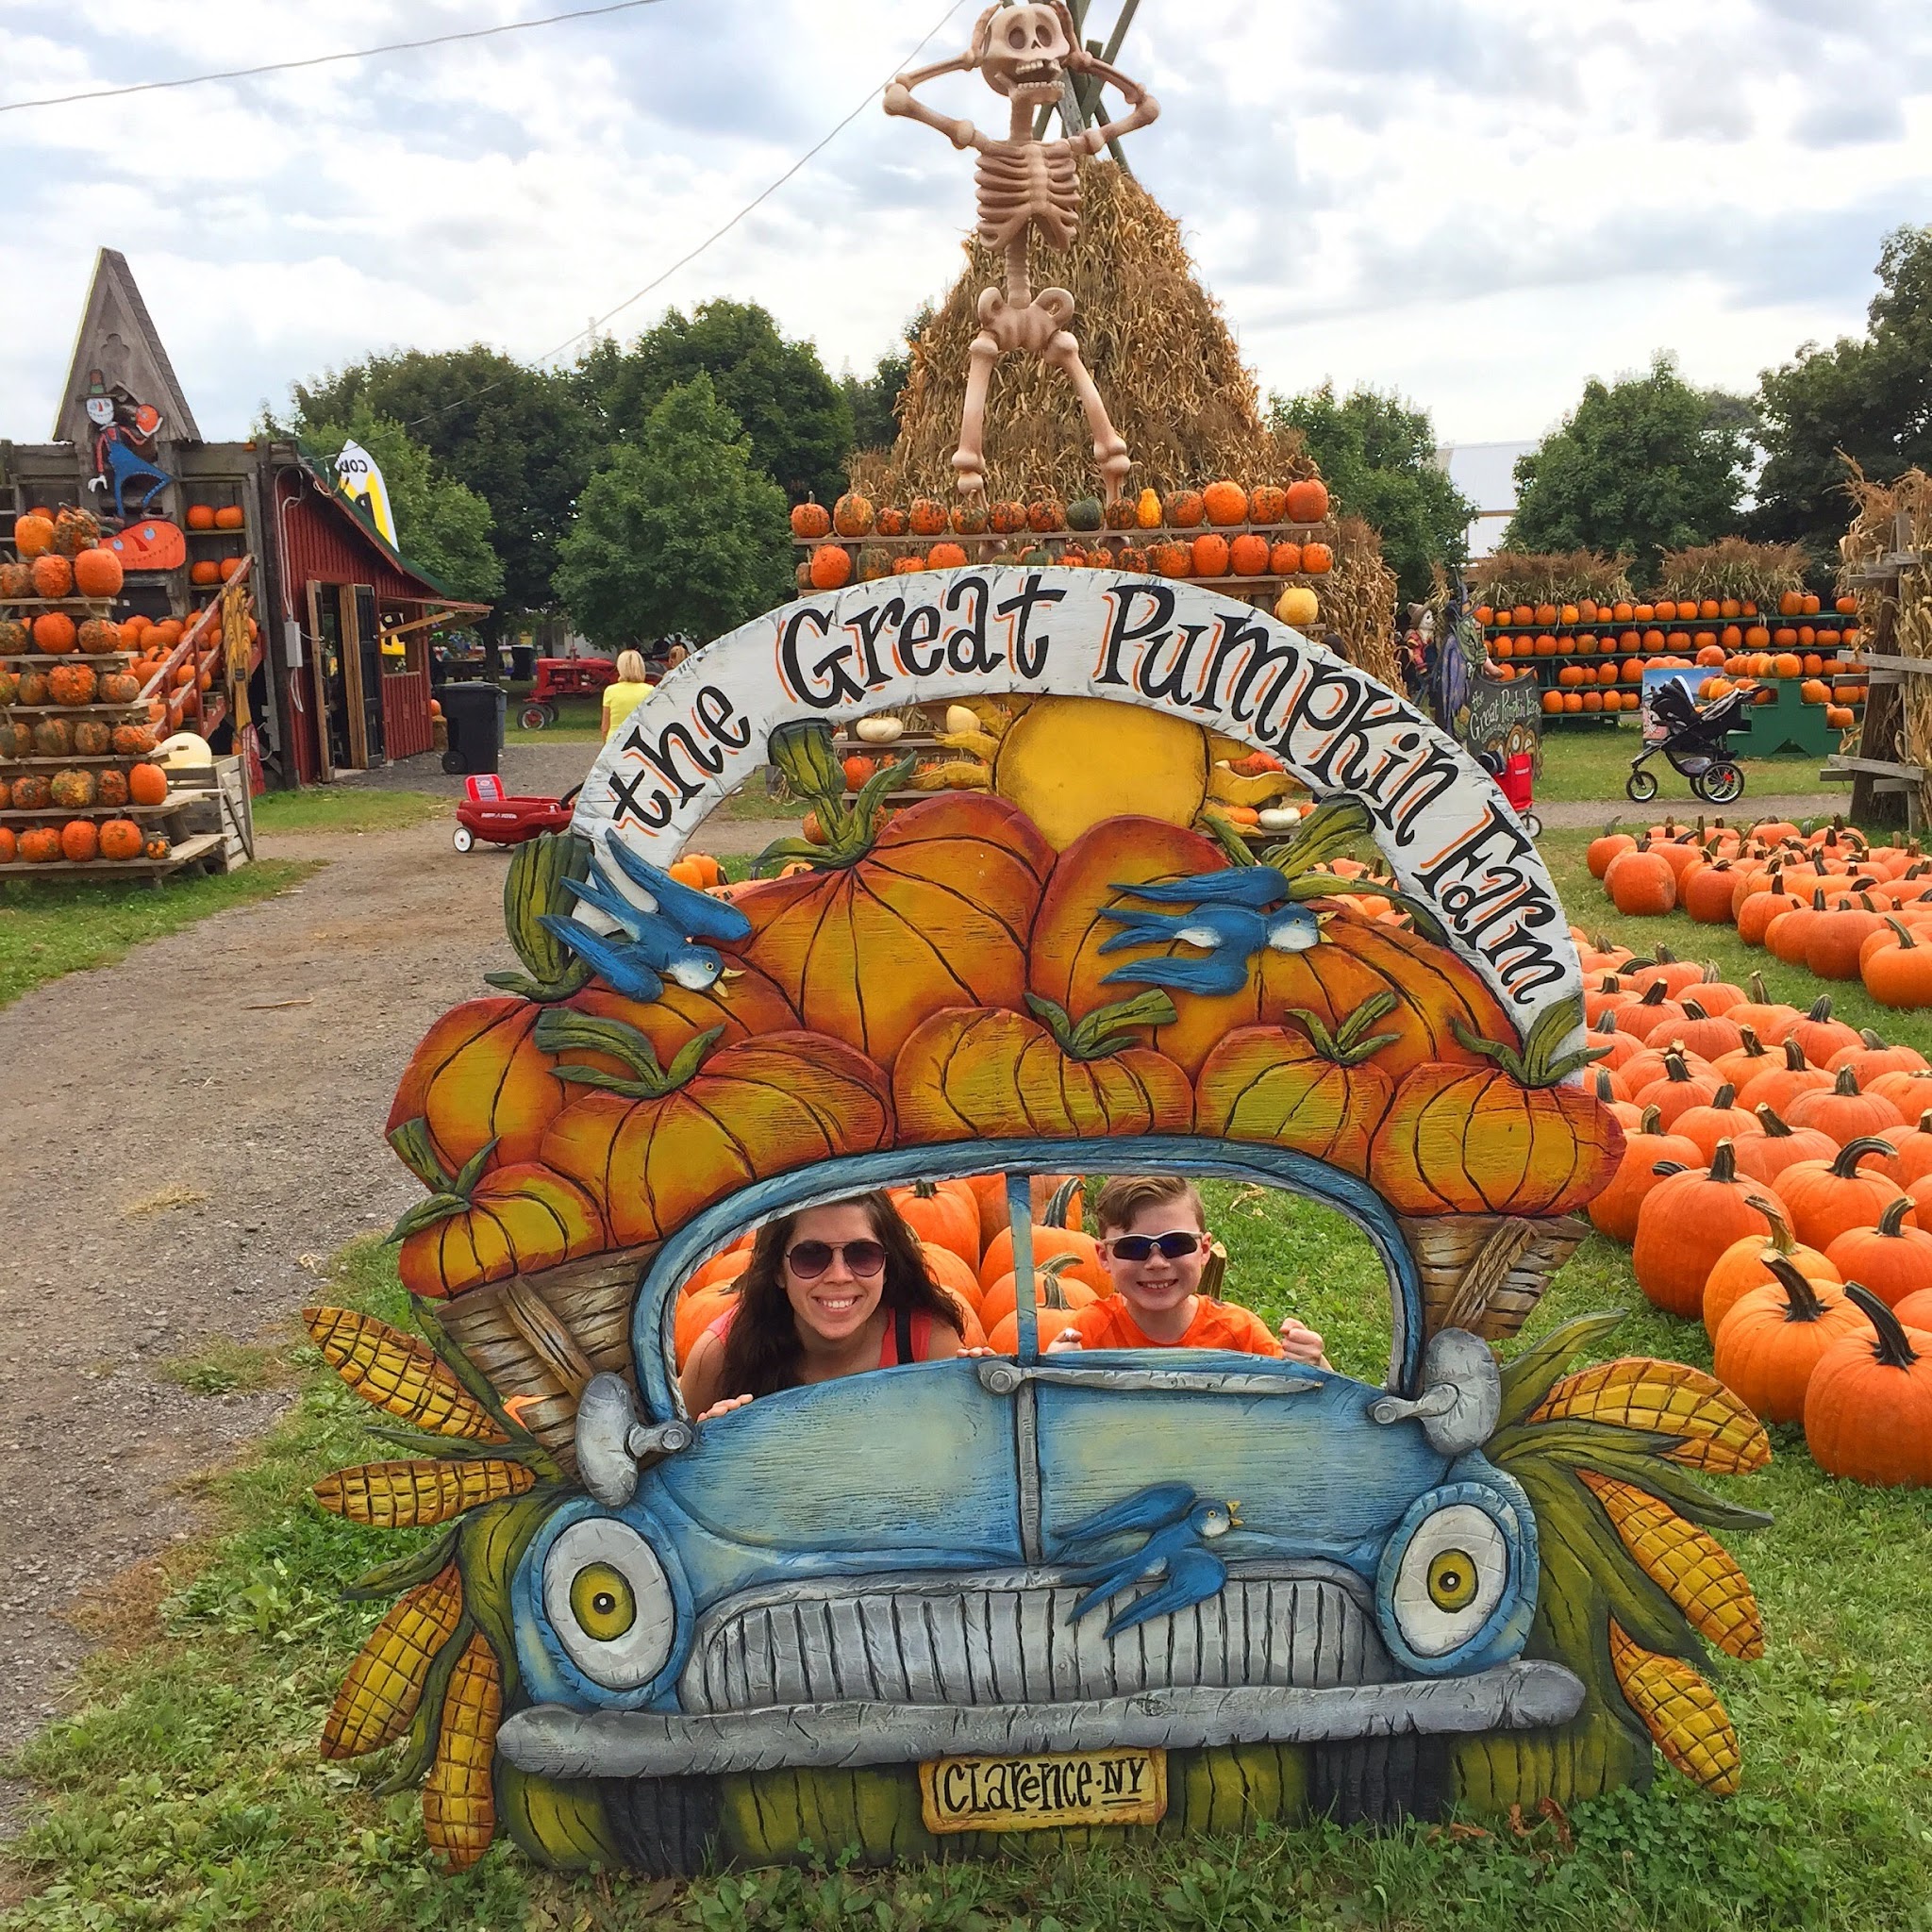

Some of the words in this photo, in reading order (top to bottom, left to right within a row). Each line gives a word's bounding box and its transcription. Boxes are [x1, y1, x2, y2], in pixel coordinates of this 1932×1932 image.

[1469, 699, 1500, 741] Great
[1472, 690, 1485, 711] the
[610, 685, 751, 829] the
[782, 574, 1067, 708] Great
[1095, 584, 1458, 847] Pumpkin
[1412, 801, 1566, 1006] Farm
